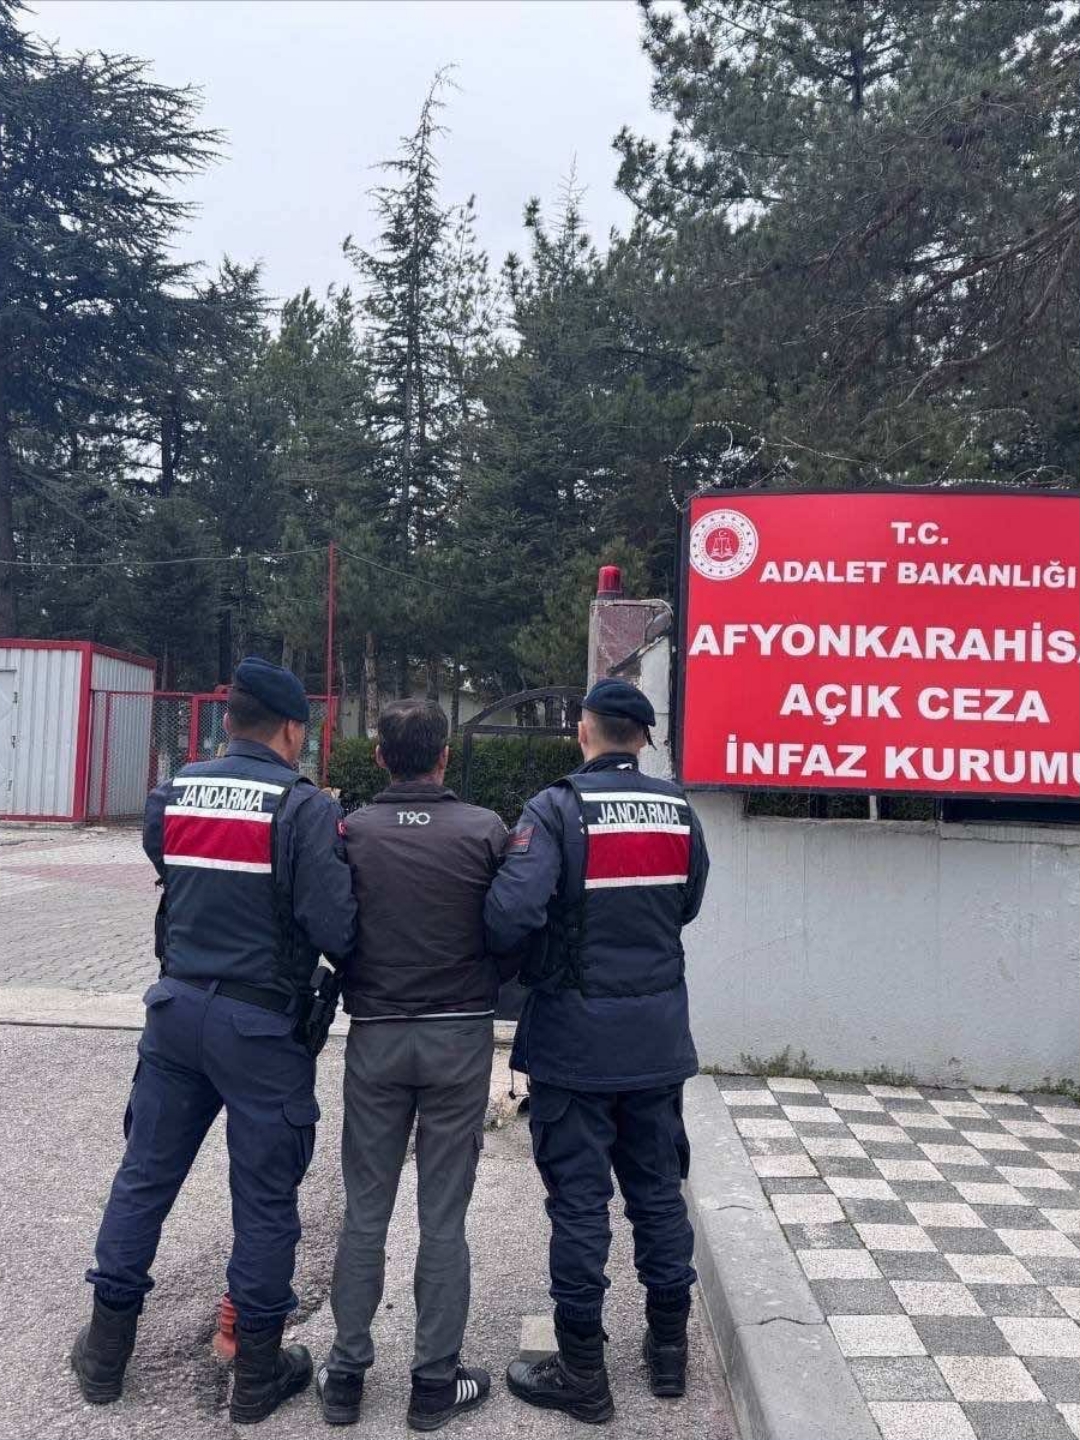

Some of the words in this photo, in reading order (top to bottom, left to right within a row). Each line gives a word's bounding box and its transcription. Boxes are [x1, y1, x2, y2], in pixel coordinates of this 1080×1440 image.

[890, 521, 949, 545] T.C.
[760, 561, 887, 583] ADALET
[898, 560, 1076, 588] BAKANLIĞI
[688, 621, 1080, 664] AFYONKARAHİS
[780, 683, 902, 725] AÇIK
[917, 687, 1050, 723] CEZA
[726, 734, 867, 778] İNFAZ
[177, 784, 264, 812] JANDARMA
[597, 802, 680, 825] JANDARMA
